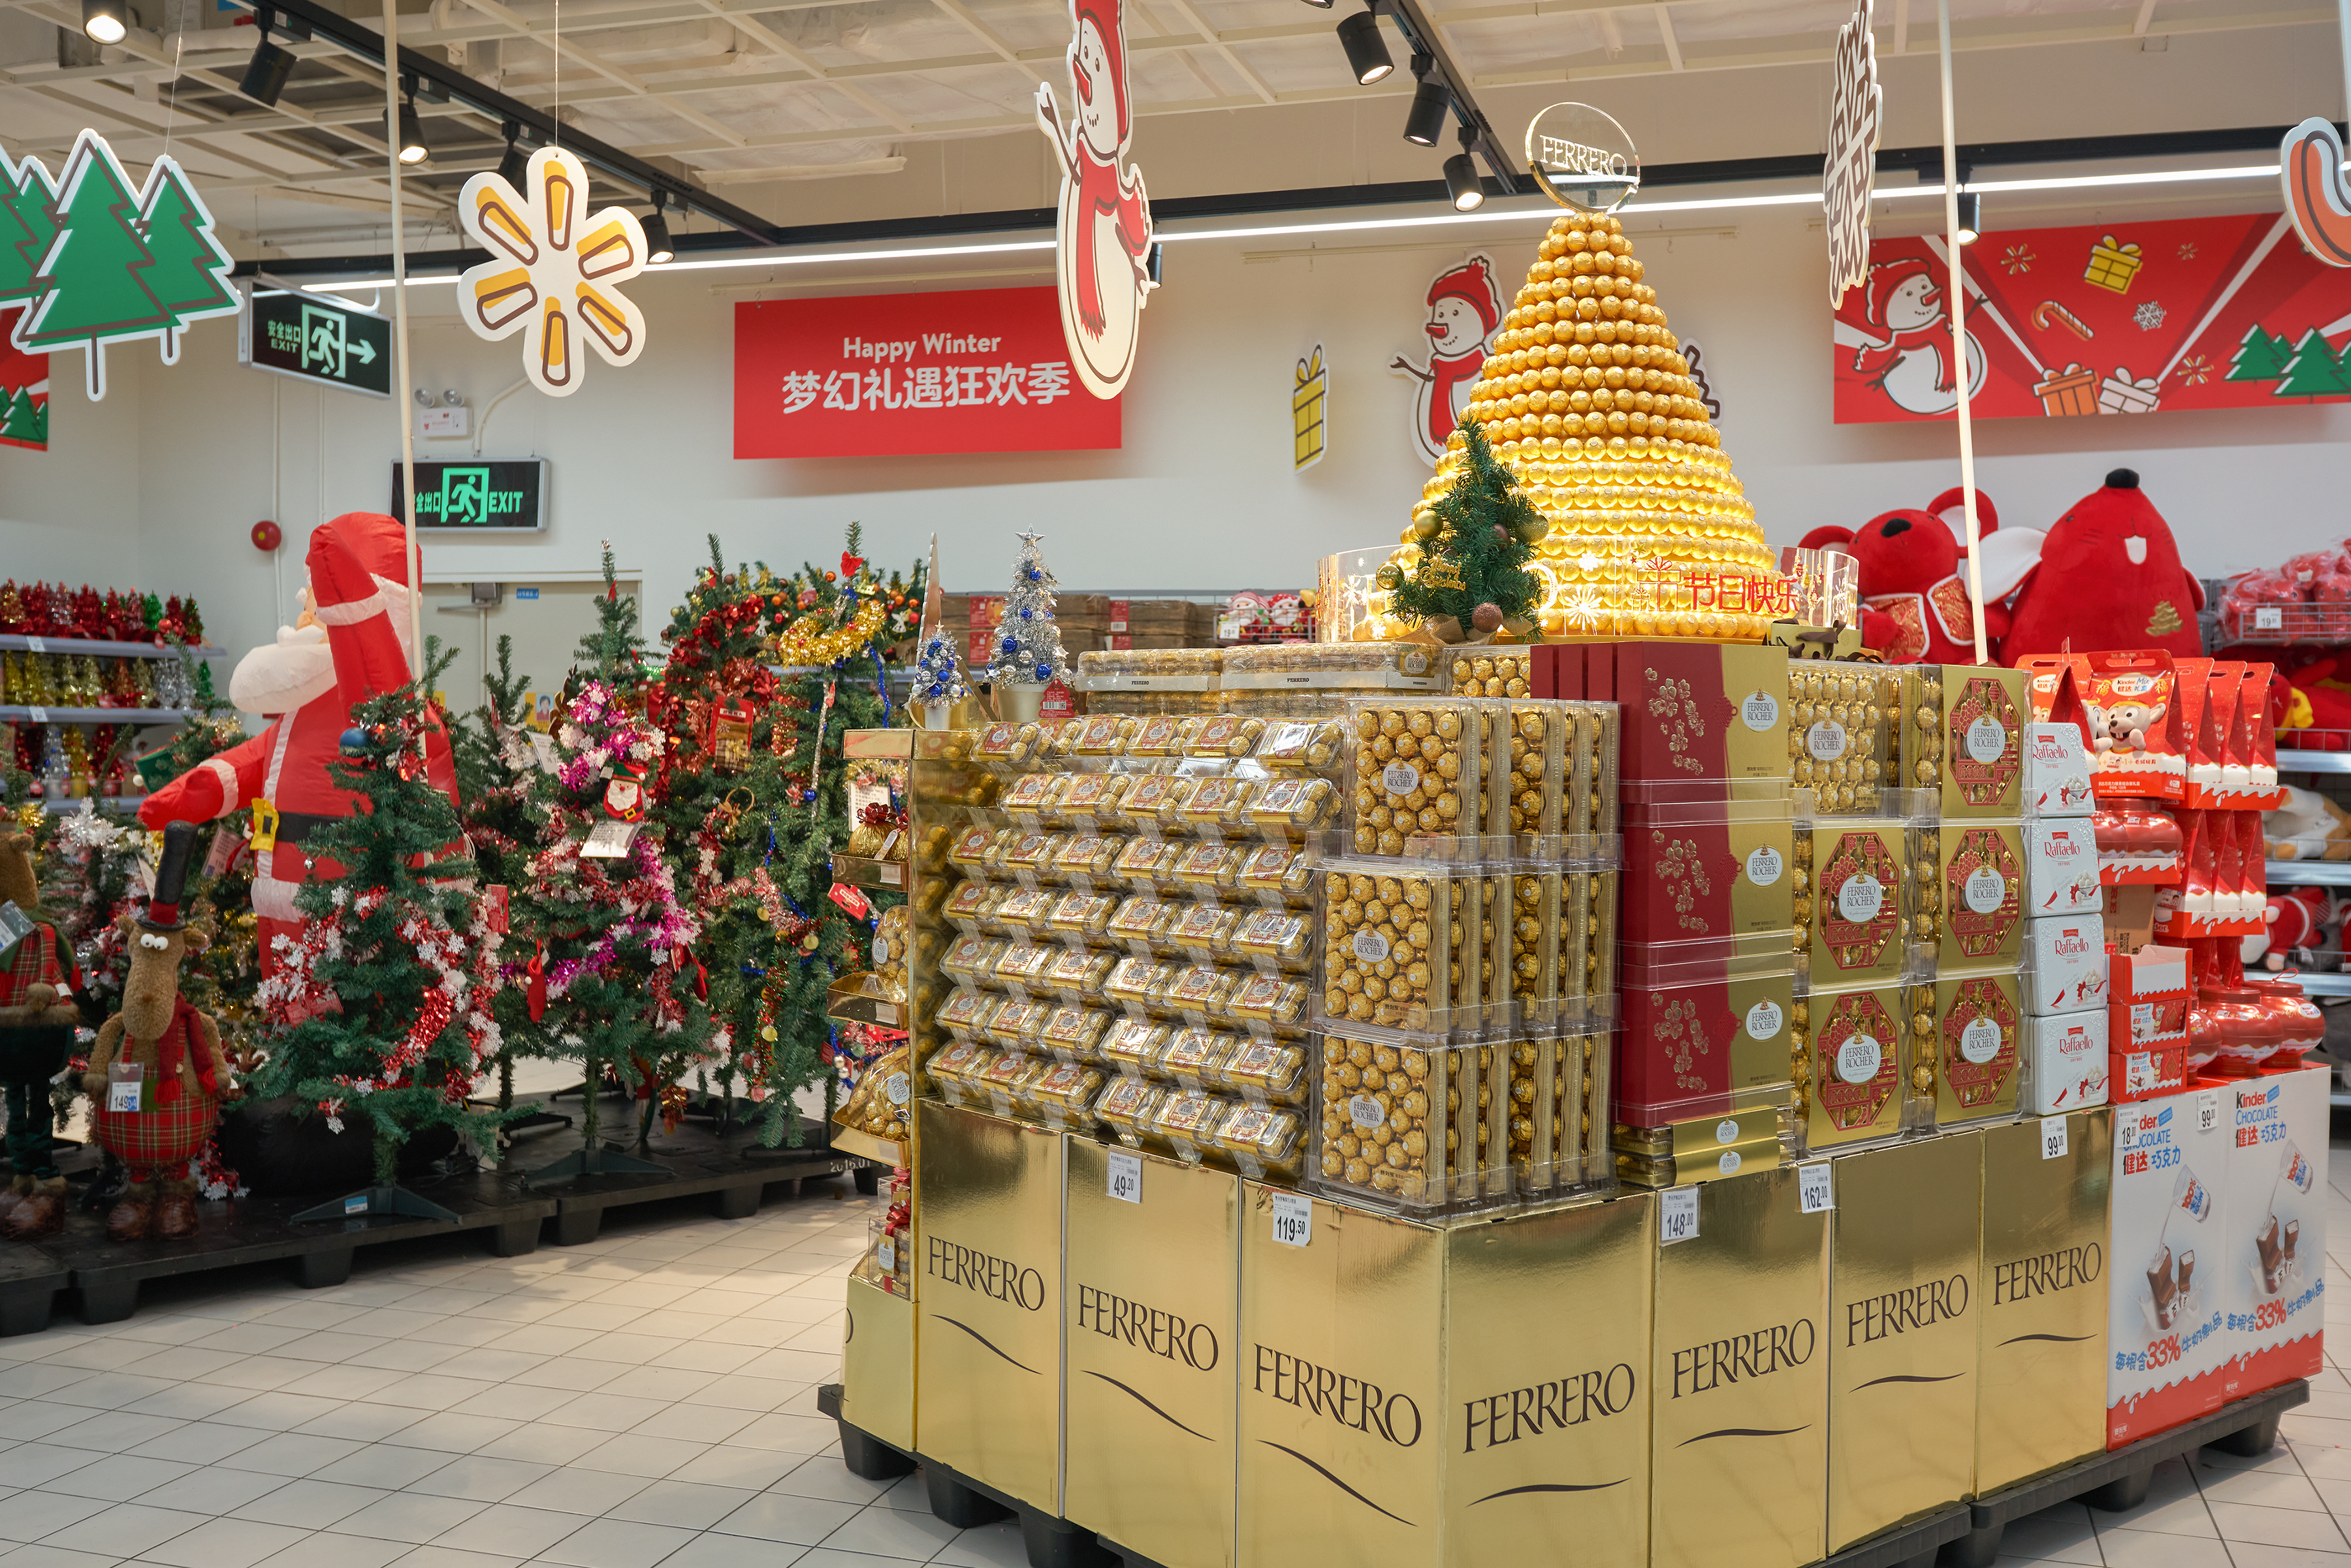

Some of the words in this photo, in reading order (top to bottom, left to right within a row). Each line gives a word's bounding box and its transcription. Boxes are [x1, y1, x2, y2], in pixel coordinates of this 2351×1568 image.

[1539, 134, 1627, 181] FERRERO
[267, 319, 301, 344] 安全出口
[270, 338, 299, 354] EXIT
[843, 336, 917, 364] Happy
[921, 332, 1002, 355] Winter
[782, 361, 1071, 415] 梦幻礼遇狂欢季
[413, 491, 442, 513] 全出口
[488, 492, 523, 513] EXIT
[1684, 571, 1800, 614] 节日快乐
[2095, 682, 2110, 696] 福
[2155, 681, 2168, 695] 福
[1747, 703, 1773, 711] FERRERO
[1747, 711, 1774, 721] ROCHER
[1814, 731, 1841, 740] FERRERO
[1975, 728, 2000, 738] FERRERO
[1814, 740, 1840, 750] ROCHER
[1974, 738, 2000, 747] ROCHER
[2033, 745, 2068, 760] Raffaello
[1388, 771, 1414, 779] FERRERO
[1960, 765, 1987, 779] 新年快乐
[1387, 778, 1413, 787] ROCHER
[2044, 841, 2080, 858] Raffaello
[1752, 857, 1778, 867] FERRERO
[1752, 866, 1778, 876] ROCHER
[1847, 885, 1876, 896] FERRERO
[1973, 879, 1999, 889] FERRERO
[1973, 889, 1999, 898] ROCHER
[1847, 896, 1875, 907] ROCHER
[2153, 923, 2169, 932] der
[1358, 937, 1384, 948] FERRERO
[2055, 938, 2089, 956] Raffaello
[1358, 945, 1384, 956] ROCHER
[1752, 1010, 1778, 1022] FERRERO
[1751, 1020, 1778, 1031] ROCHER
[1969, 1028, 1995, 1040] FERRERO
[1969, 1038, 1995, 1049] ROCHER
[2059, 1035, 2093, 1055] Raffaello
[1846, 1045, 1874, 1058] FERRERO
[1846, 1056, 1875, 1069] ROCHER
[1354, 1101, 1380, 1114] FERRERO
[1354, 1109, 1380, 1122] ROCHER
[2236, 1105, 2278, 1125] CHOCOLATE
[2140, 1114, 2158, 1131] der
[2235, 1125, 2258, 1148] 健达
[2261, 1121, 2287, 1143] 巧克力
[2123, 1150, 2148, 1175] 健达
[2151, 1145, 2181, 1169] 巧克力
[1114, 1174, 1134, 1196] 49.20
[1804, 1185, 1828, 1209] 162.00
[1277, 1215, 1305, 1242] 119.50
[1667, 1212, 1693, 1237] 148.00
[927, 1235, 1045, 1311] FERRERO
[1993, 1242, 2102, 1306] FERRERO
[1846, 1274, 1969, 1347] FERRERO
[1077, 1282, 1219, 1371] FERRERO
[1671, 1318, 1815, 1400] FERRERO
[1253, 1343, 1422, 1447] FERRERO
[1463, 1363, 1635, 1454] FERRERO
